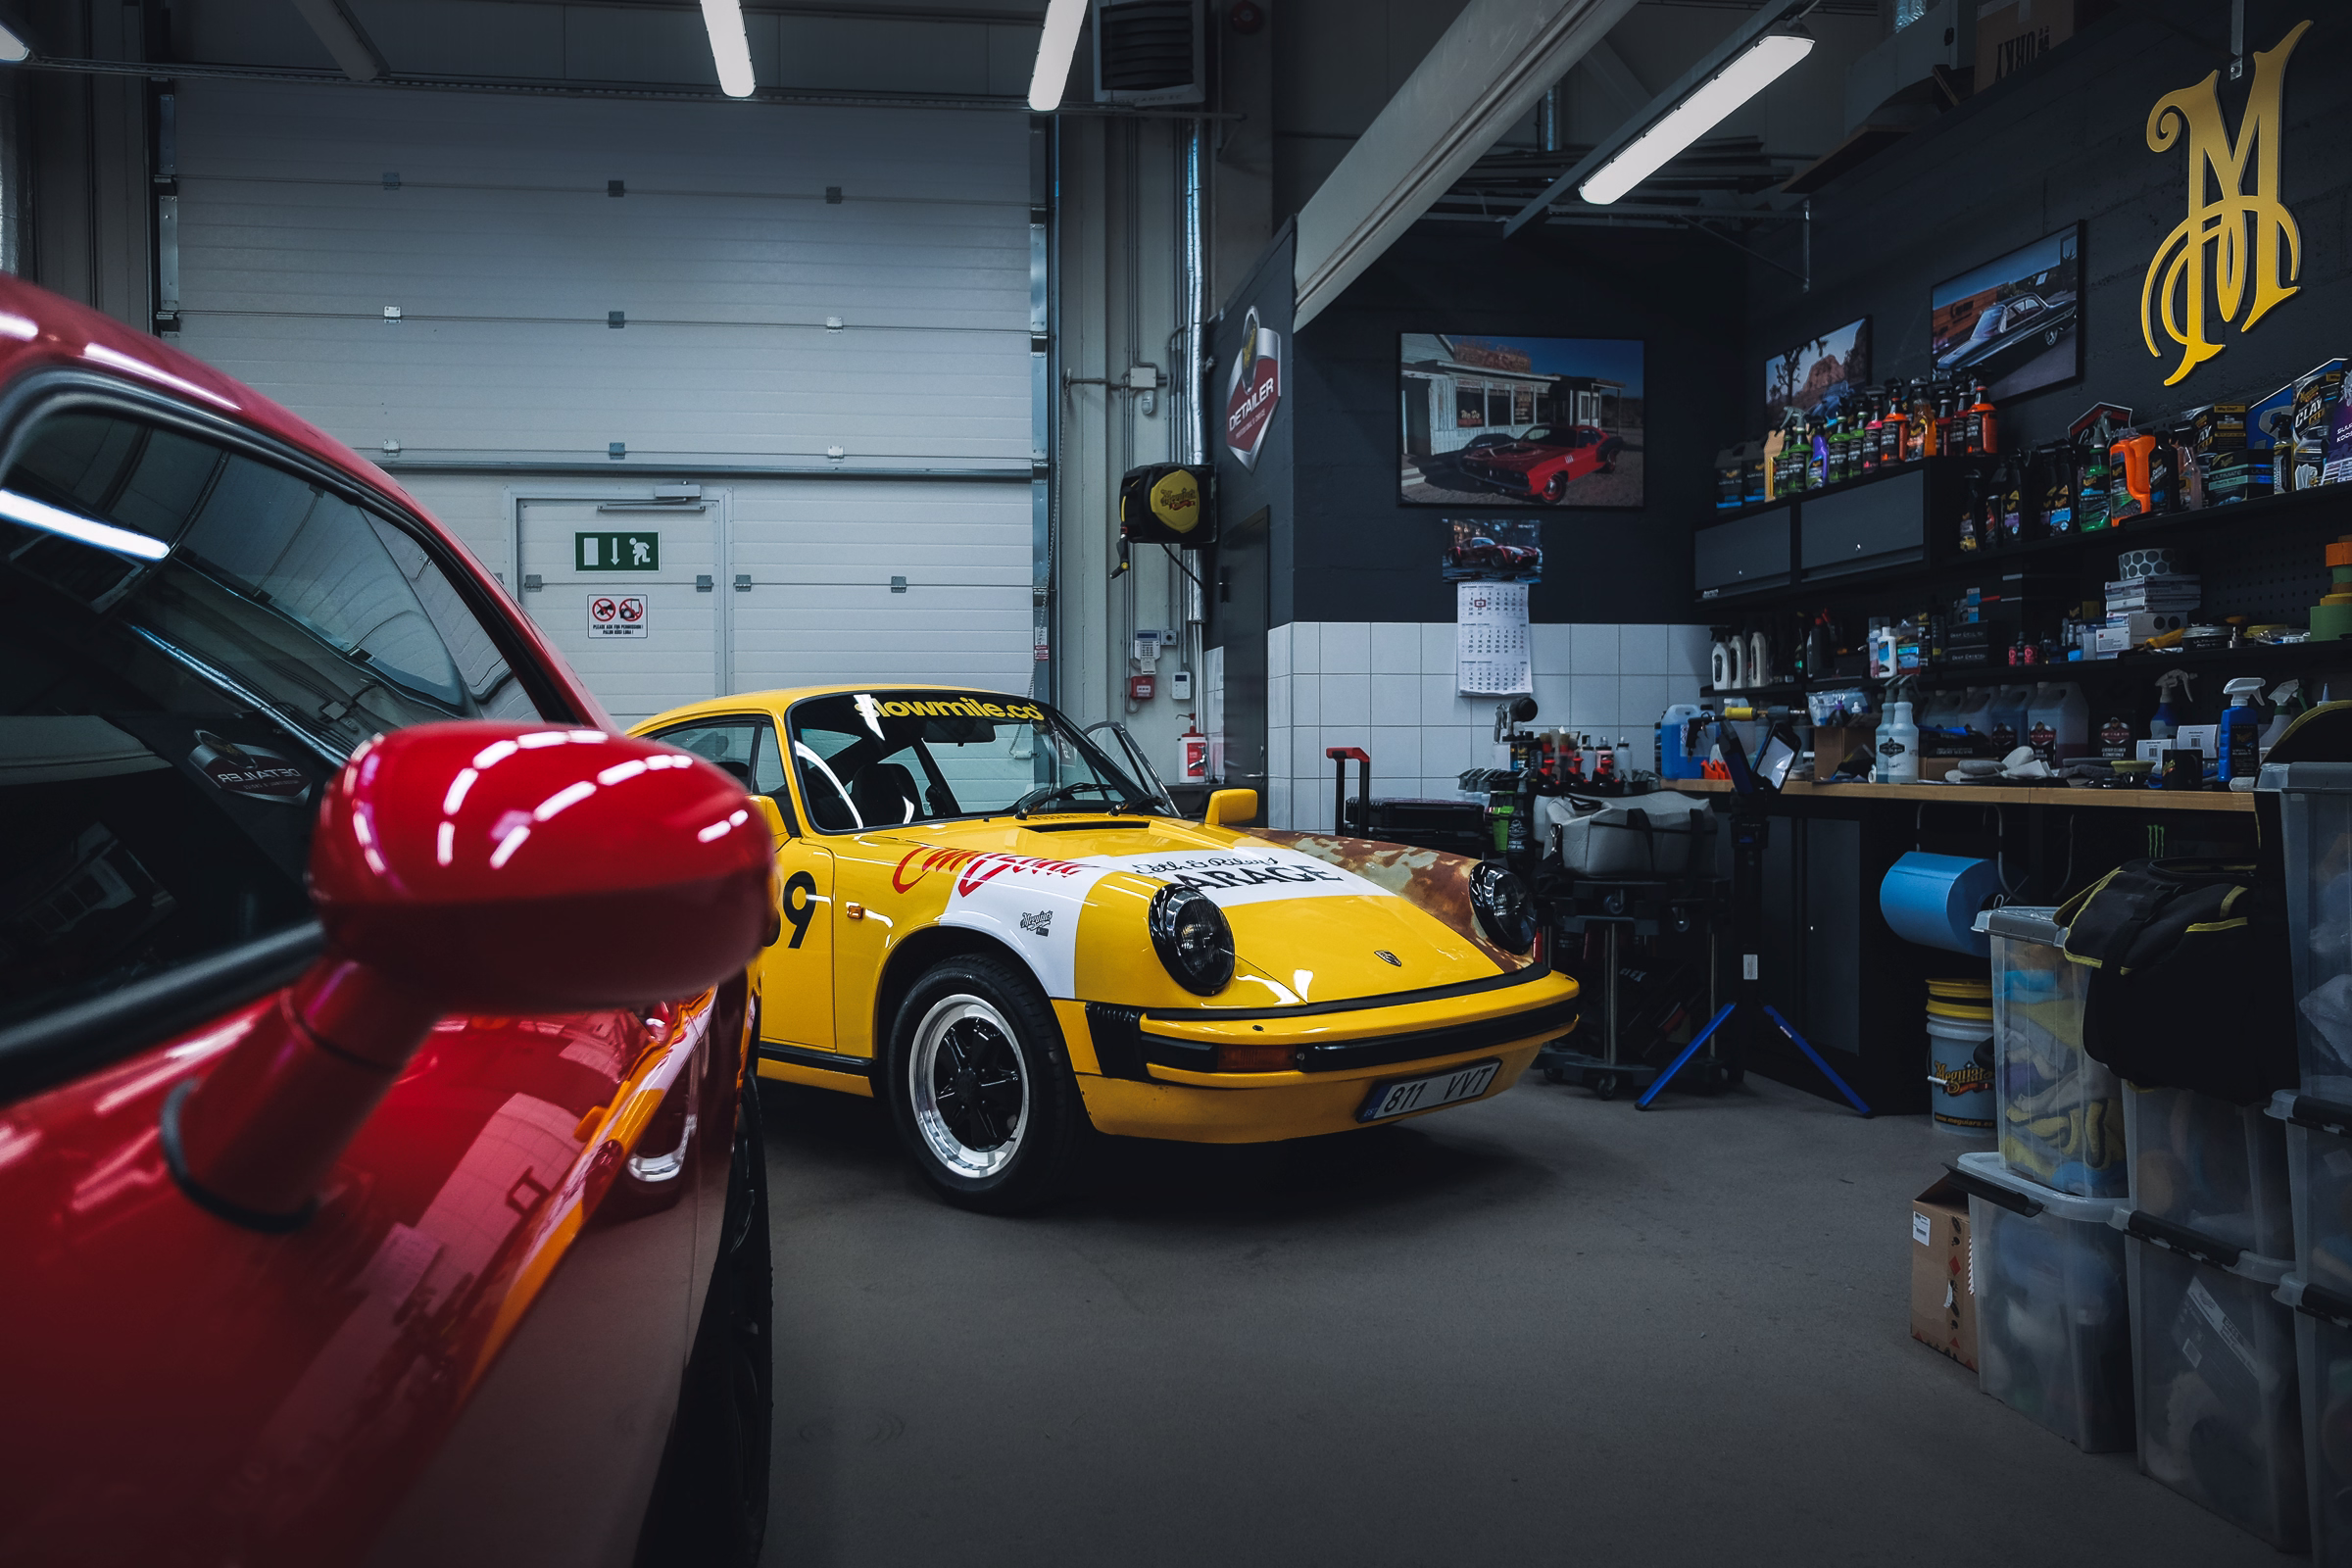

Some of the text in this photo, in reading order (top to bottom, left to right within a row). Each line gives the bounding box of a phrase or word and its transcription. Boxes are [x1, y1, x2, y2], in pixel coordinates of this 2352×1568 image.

[1229, 377, 1273, 432] DETAILER
[2295, 397, 2323, 428] CLAY
[2212, 469, 2242, 480] ULTIMATE
[855, 697, 1045, 721] lowmile.co
[1173, 864, 1344, 891] ARAGE
[1384, 1066, 1493, 1113] 811 VVT
